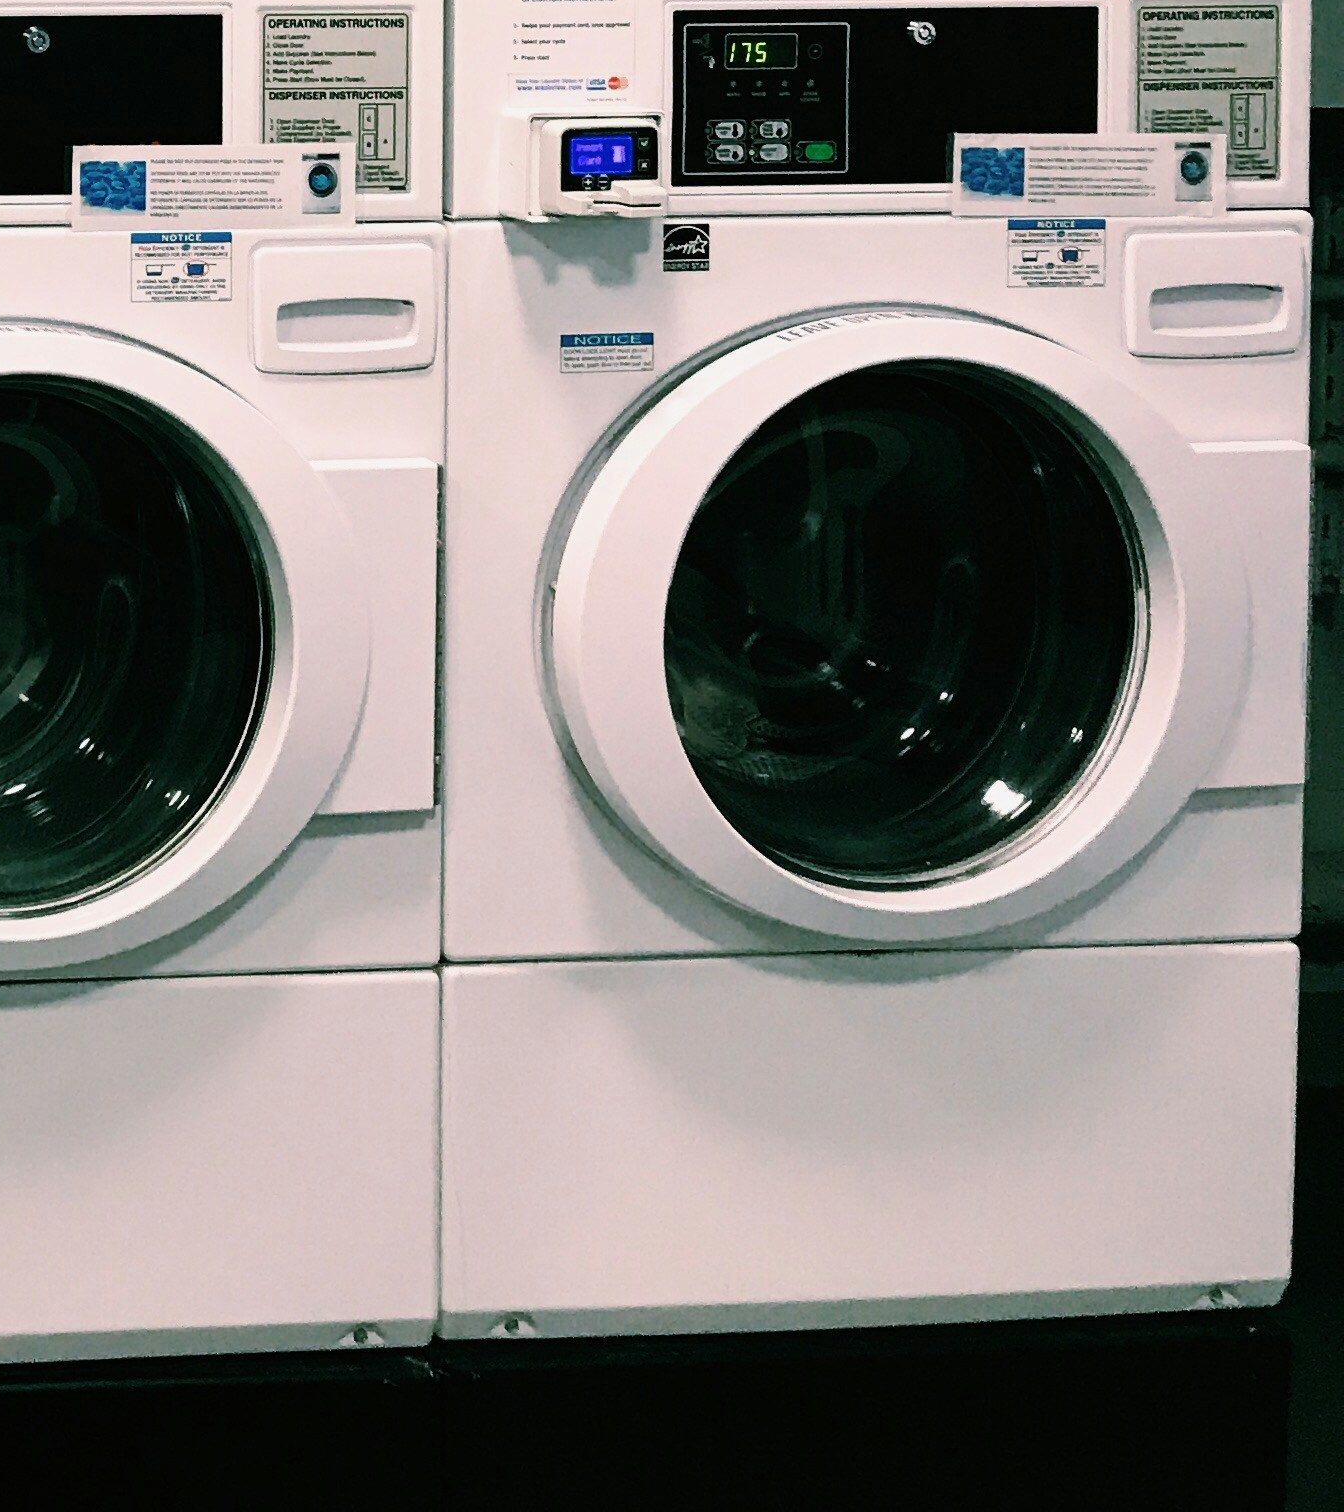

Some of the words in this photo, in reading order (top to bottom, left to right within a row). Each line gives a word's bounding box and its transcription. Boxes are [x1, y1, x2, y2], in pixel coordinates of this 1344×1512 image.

[1143, 11, 1199, 21] OPERATING
[1202, 10, 1275, 20] INSTRUCTIONS
[268, 19, 327, 28] OPERATING
[330, 18, 404, 28] INSTRUCTIONS
[729, 42, 767, 63] 175
[269, 92, 326, 100] DISPENSER
[329, 91, 403, 100] INSTRUCTIONS
[1037, 220, 1075, 228] NOTICE
[162, 233, 202, 242] NOTICE
[574, 335, 642, 345] NOTICE
